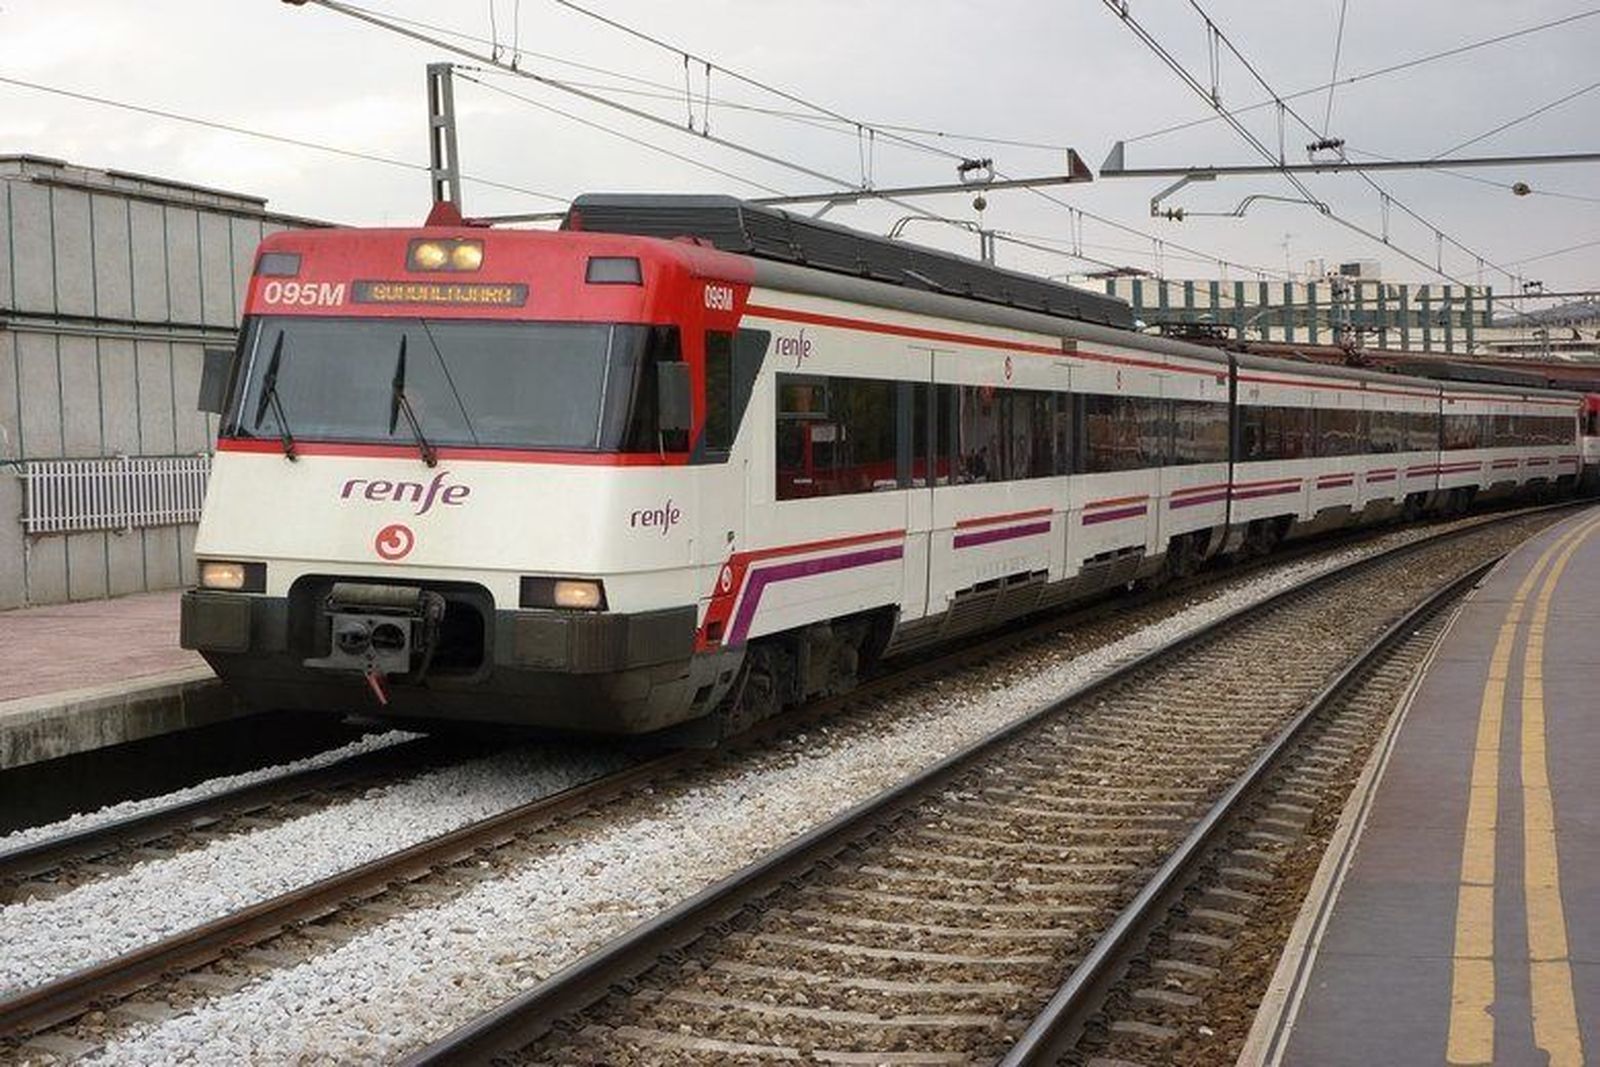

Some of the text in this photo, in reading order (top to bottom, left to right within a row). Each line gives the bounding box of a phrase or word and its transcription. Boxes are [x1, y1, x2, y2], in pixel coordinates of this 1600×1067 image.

[263, 281, 345, 307] 095M
[704, 284, 734, 311] 095M
[775, 328, 812, 368] renfe
[341, 471, 470, 515] renfe
[630, 498, 680, 535] renfe
